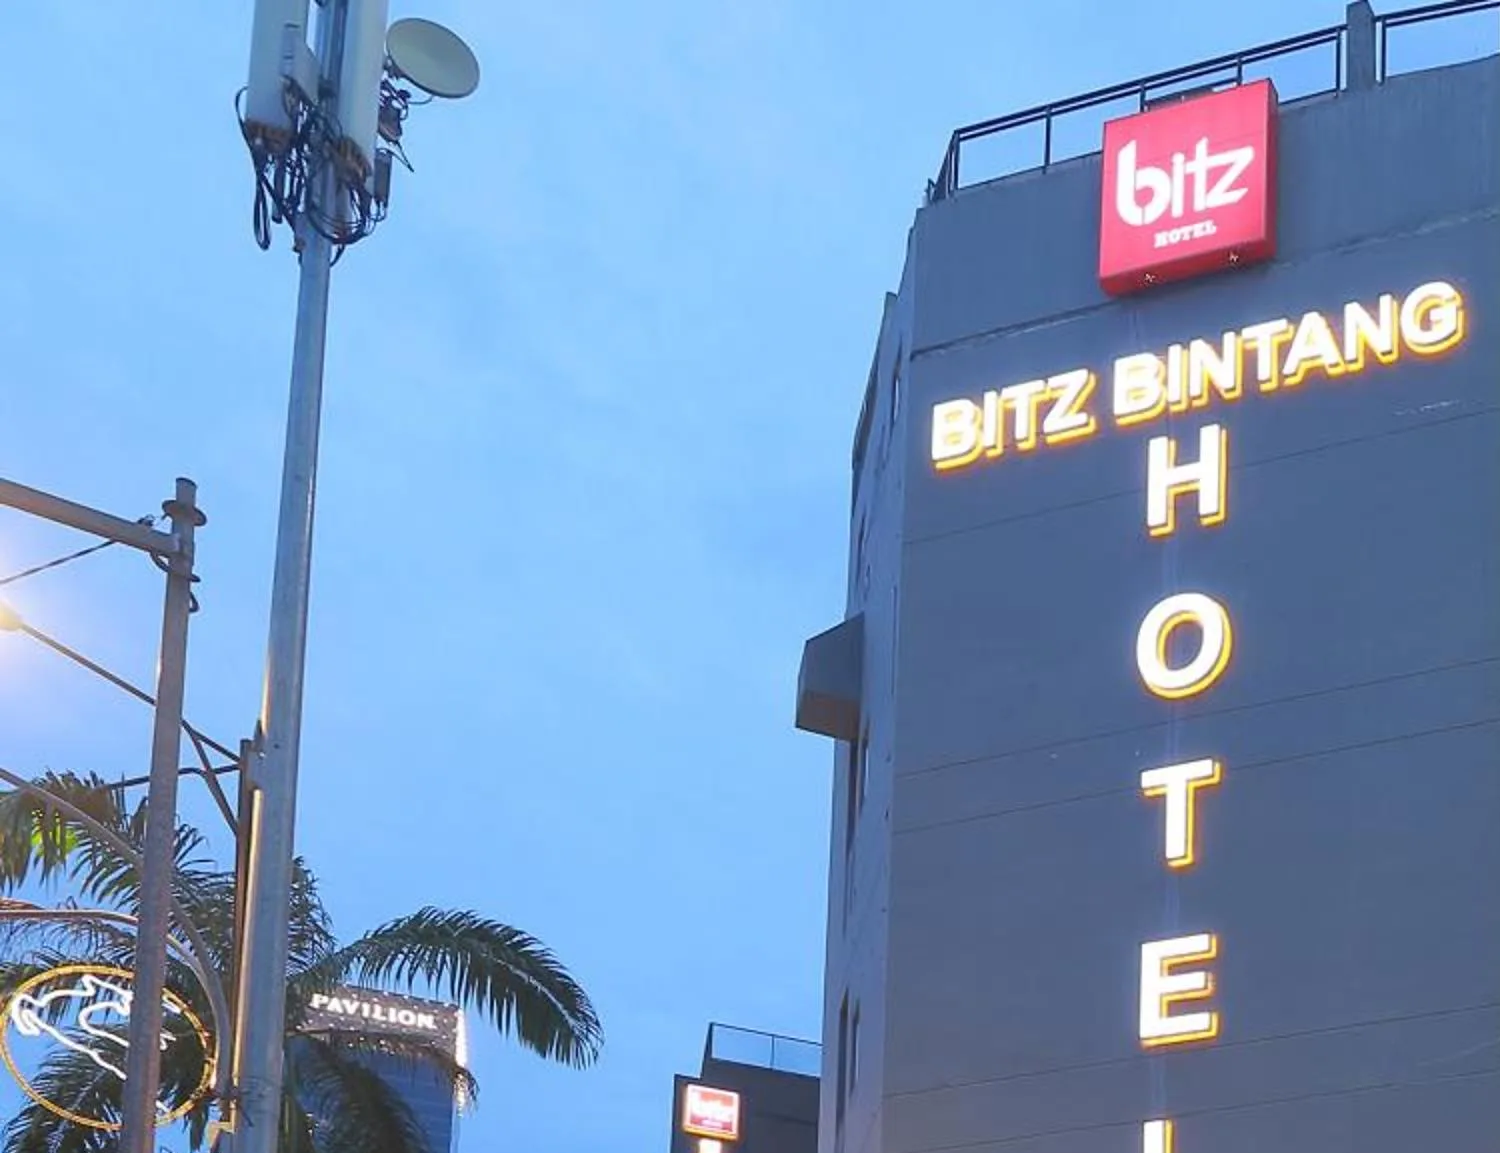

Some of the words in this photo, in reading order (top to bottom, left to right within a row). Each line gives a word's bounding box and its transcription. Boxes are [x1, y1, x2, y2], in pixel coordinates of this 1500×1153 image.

[1116, 137, 1254, 225] bitz
[1154, 221, 1217, 248] HOTEL
[931, 368, 1095, 470] BITZ
[1112, 281, 1467, 425] BINTANG
[309, 993, 437, 1029] PAVILION
